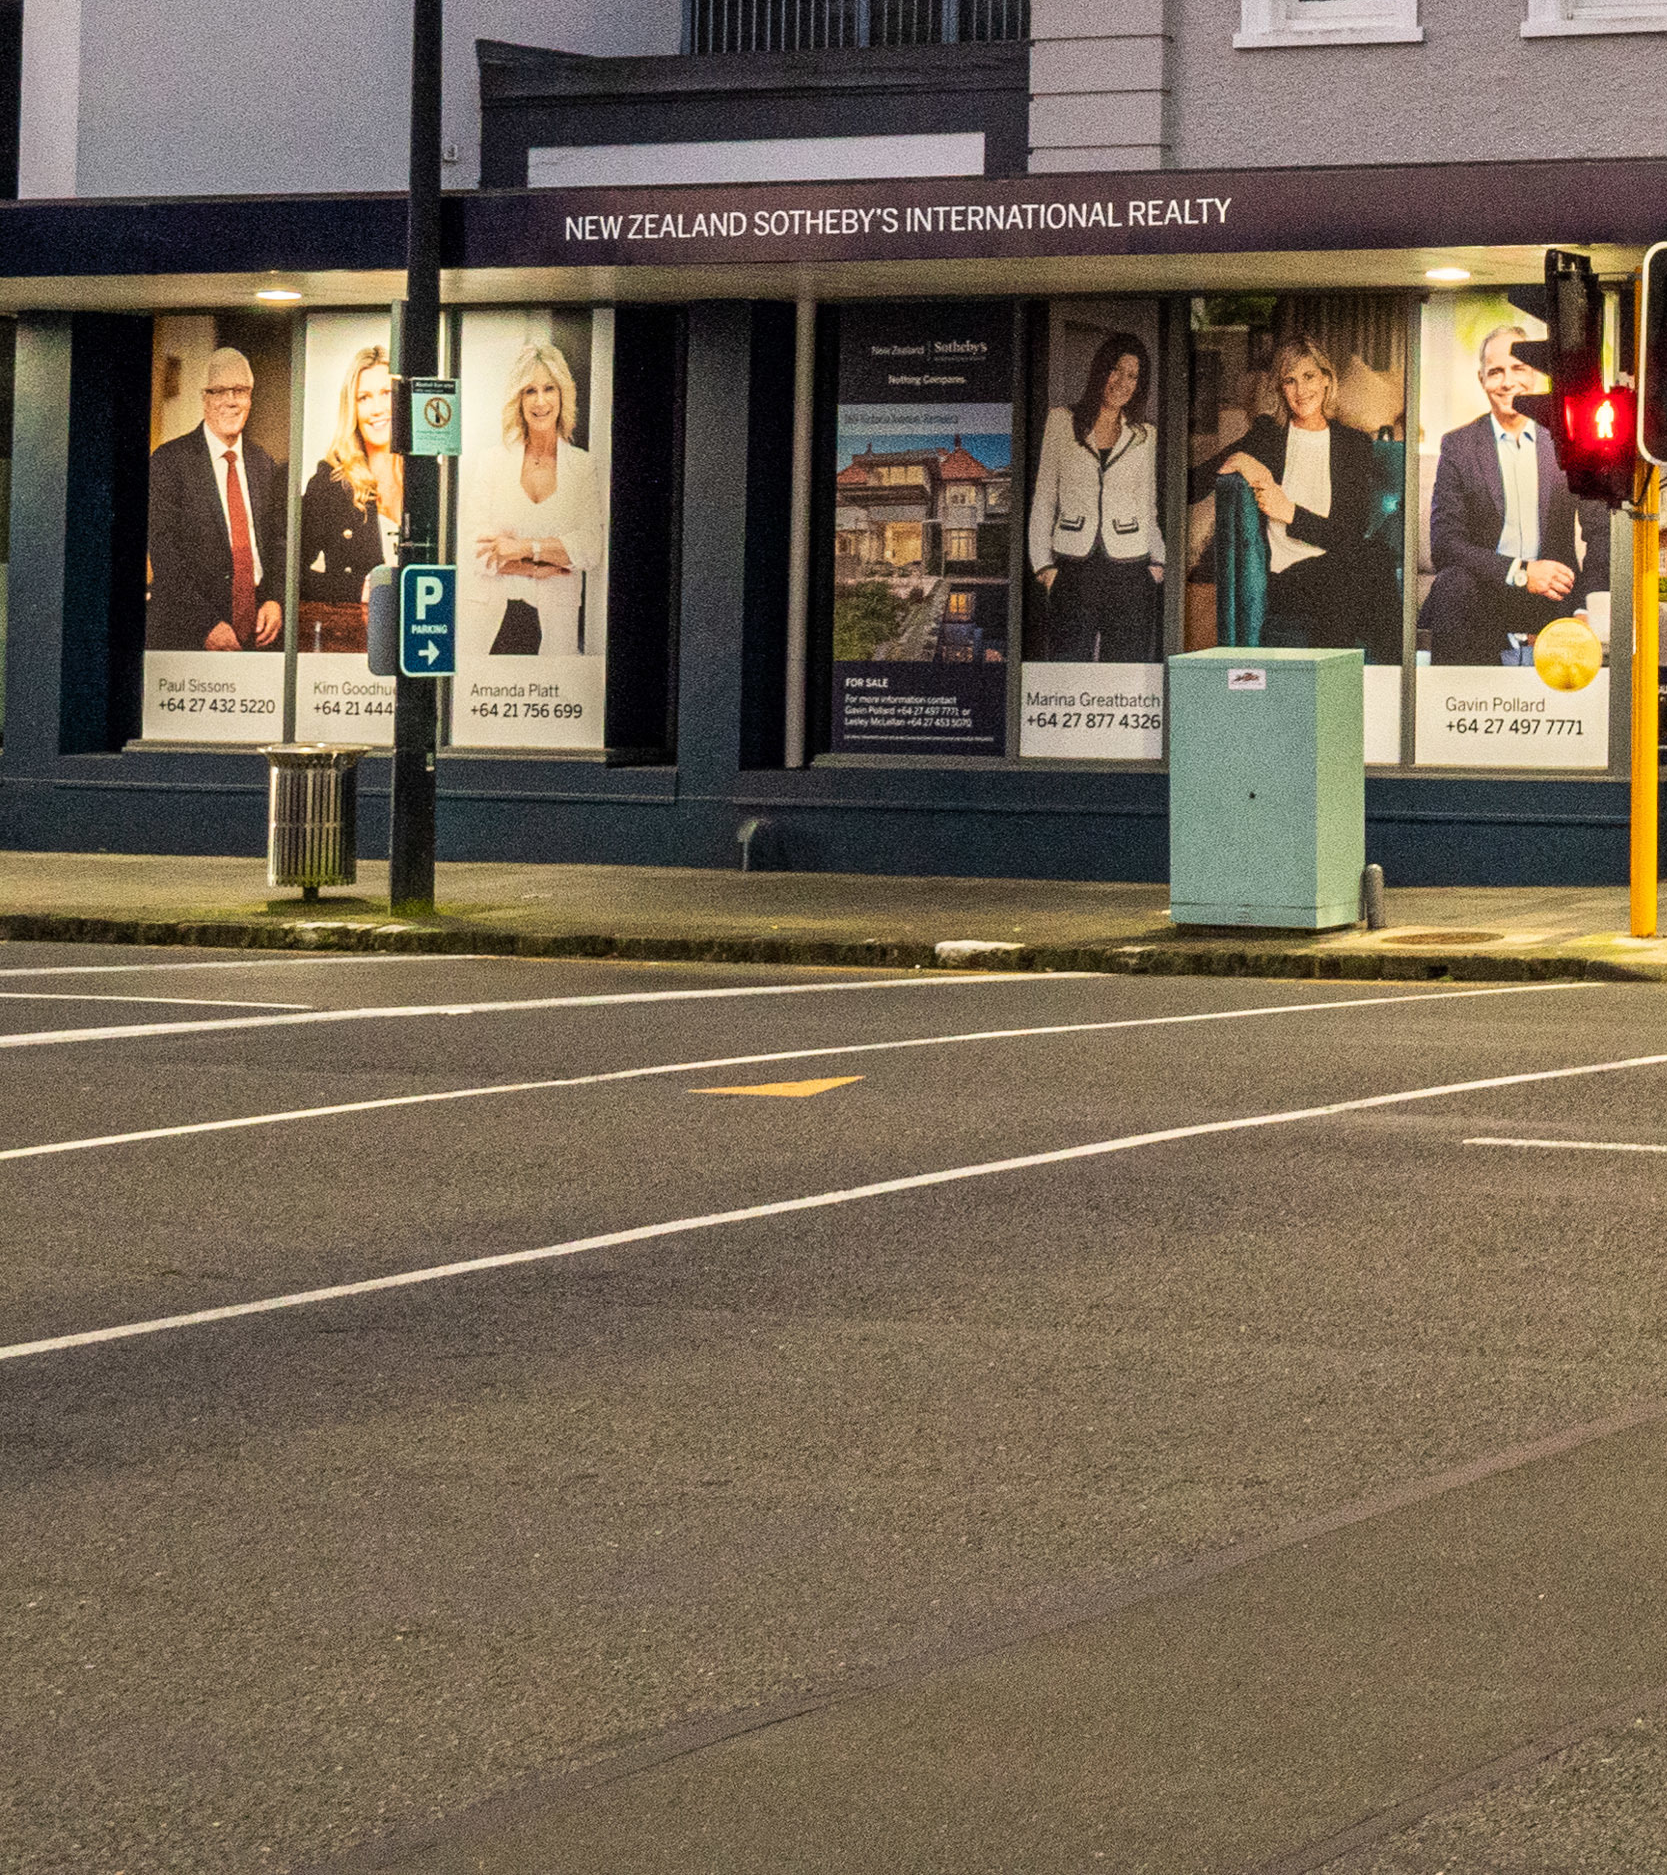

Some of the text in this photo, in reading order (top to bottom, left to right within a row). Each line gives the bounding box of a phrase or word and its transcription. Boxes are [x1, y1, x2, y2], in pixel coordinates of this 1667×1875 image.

[565, 197, 1233, 242] NEW ZEALAND SOTHEBY'S INTERNATIONAL REALTY
[933, 339, 988, 355] Sotheby's
[416, 576, 443, 620] P
[411, 624, 449, 635] PARKING
[158, 677, 237, 693] Paul Sissons
[313, 681, 339, 695] Kim
[470, 683, 560, 698] Amanda Platt
[845, 677, 889, 689] FOR SALE
[159, 698, 276, 714] +64 27 432 5220
[844, 693, 858, 704] For
[926, 695, 957, 705] contact
[1026, 691, 1161, 708] Marina Greatbatch
[1445, 696, 1546, 713] Gavin Pollard
[314, 701, 395, 716] +64 21 444
[471, 702, 583, 719] +64 21 756 699
[1027, 712, 1161, 730] +64 27 877 4326
[1446, 718, 1584, 736] +64 27 497 7771
